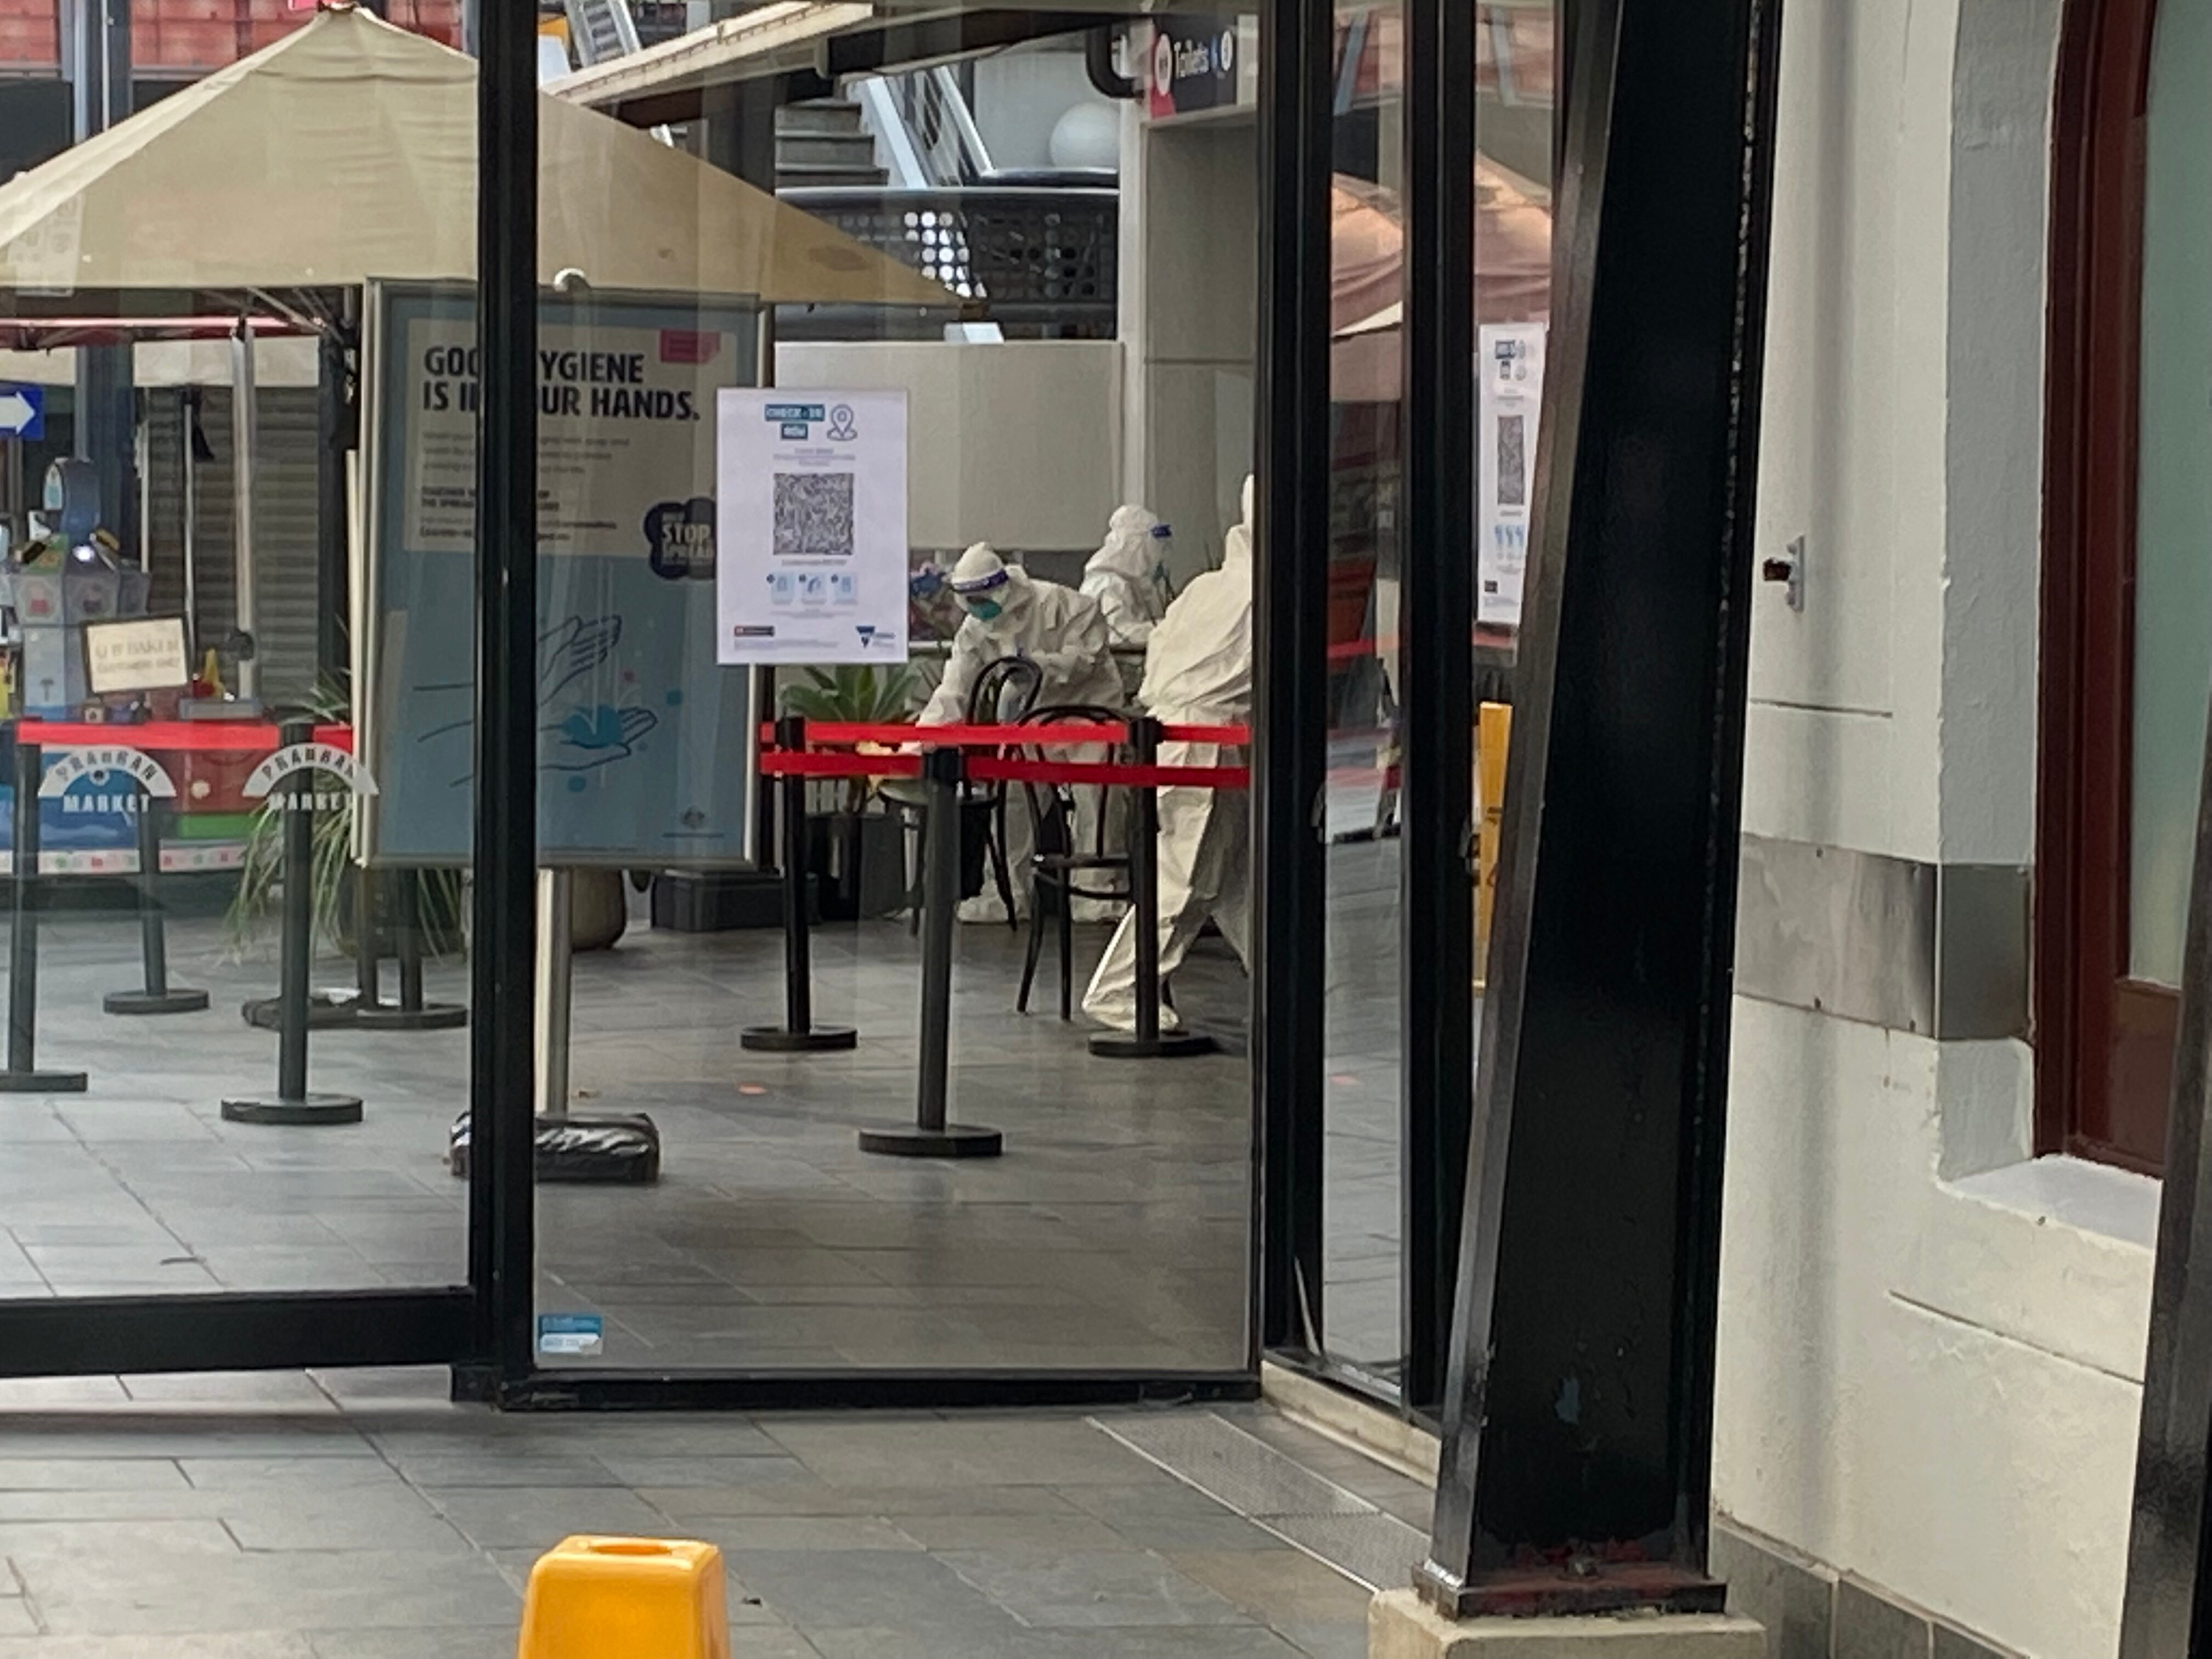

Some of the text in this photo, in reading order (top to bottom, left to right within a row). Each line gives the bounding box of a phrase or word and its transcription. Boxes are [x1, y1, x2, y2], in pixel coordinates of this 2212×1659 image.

[424, 347, 645, 383] GOO YGIENE
[424, 382, 449, 411] IS
[540, 386, 581, 416] UR
[591, 387, 700, 420] HANDS.
[662, 522, 711, 544] STOP
[55, 751, 157, 781] PRAHRAN
[63, 794, 149, 812] MARKET
